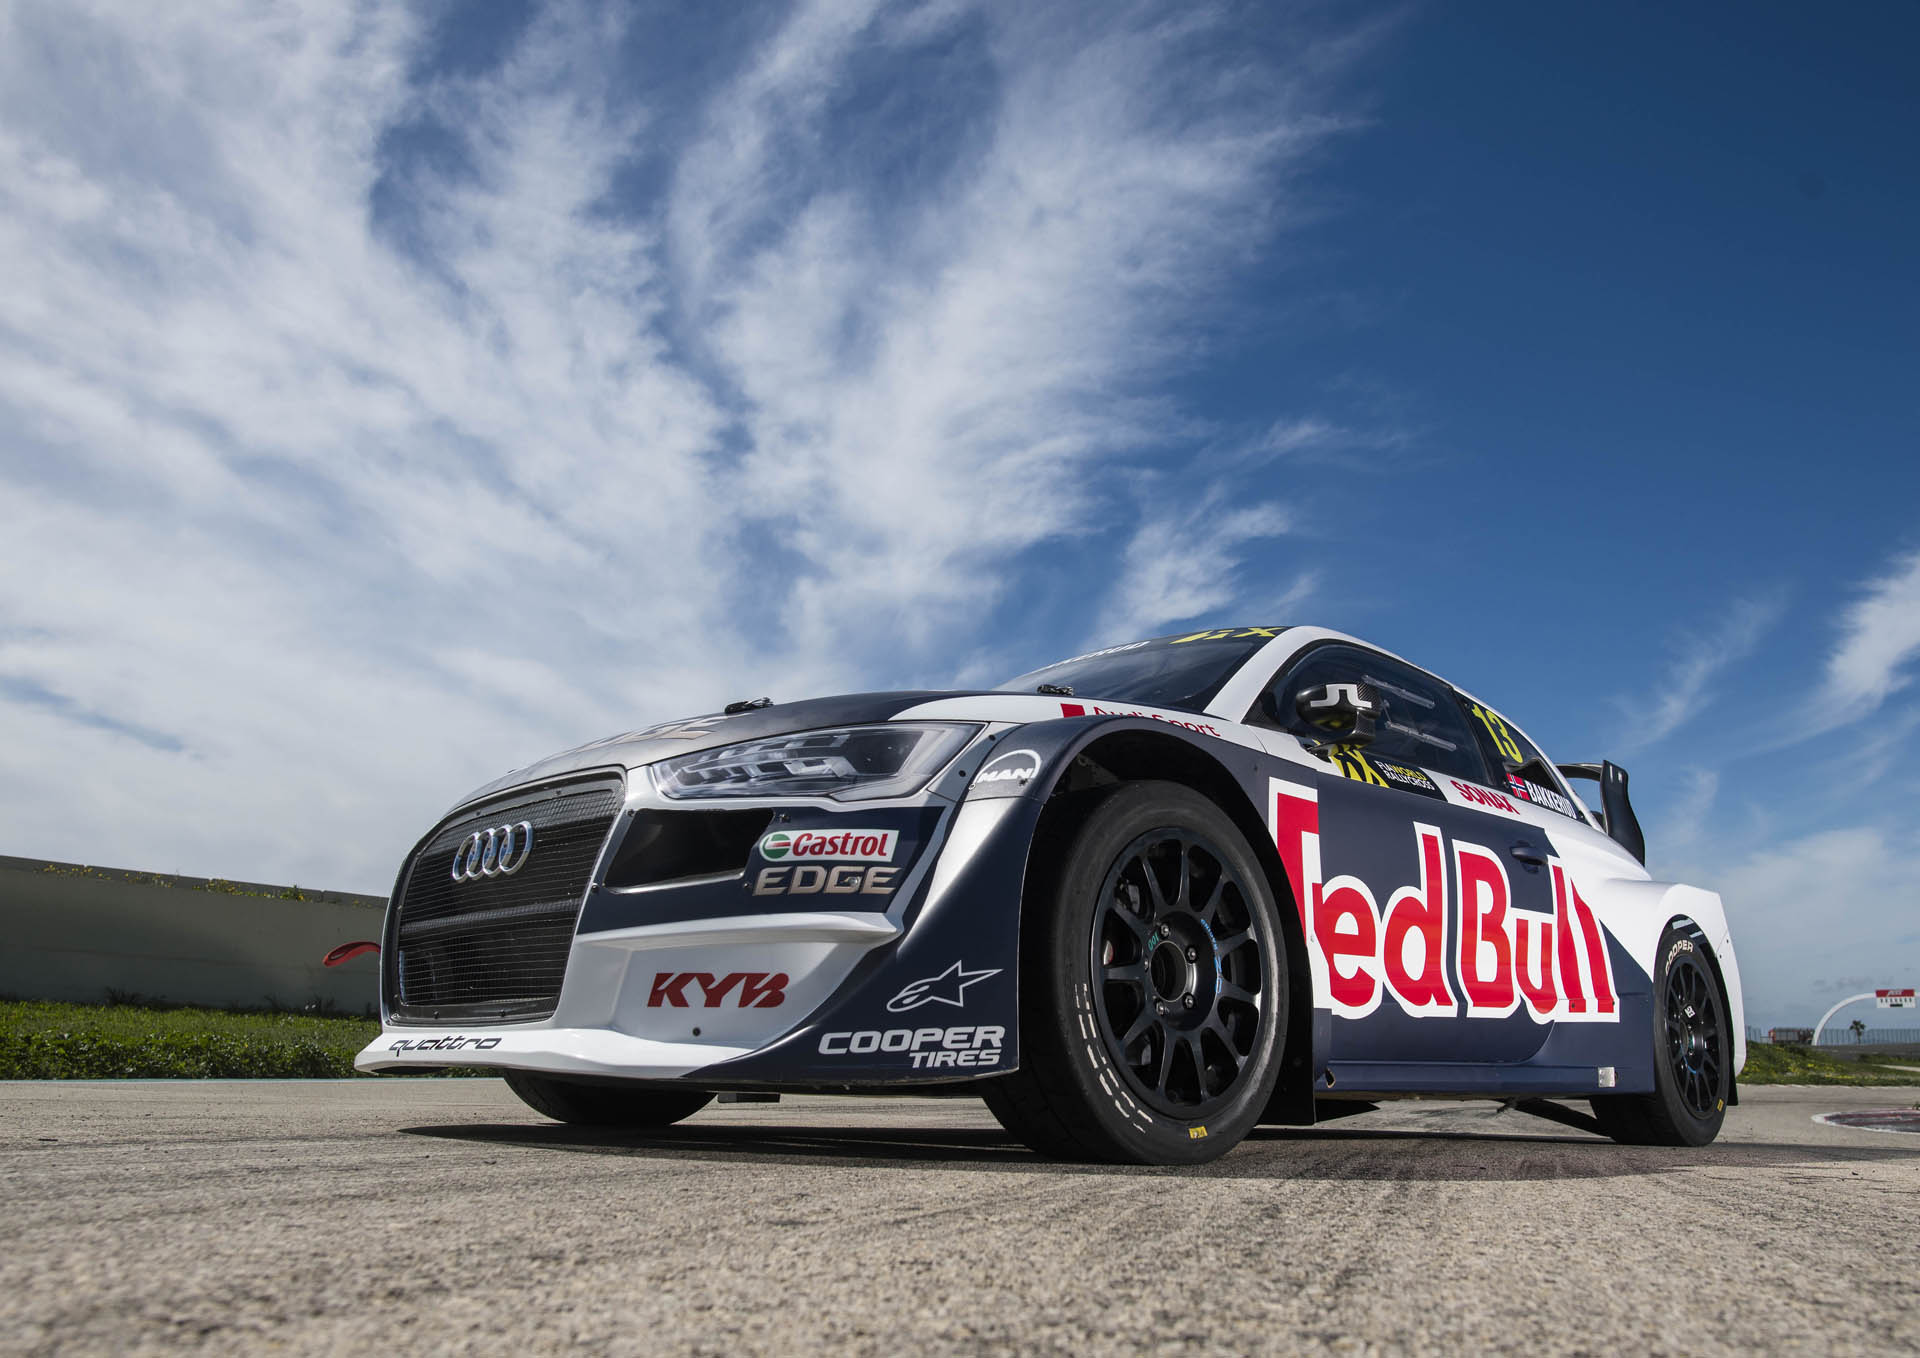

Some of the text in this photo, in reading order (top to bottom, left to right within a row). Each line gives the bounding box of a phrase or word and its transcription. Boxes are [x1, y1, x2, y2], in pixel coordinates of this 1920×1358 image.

[1472, 703, 1523, 763] 13
[977, 767, 1034, 783] MAN
[1383, 770, 1435, 791] RALLYCROSS
[1450, 780, 1521, 815] SONAX
[1524, 779, 1577, 819] BAKKERUD
[792, 831, 888, 857] Castrol
[752, 865, 902, 896] EDGE
[1458, 850, 1616, 1015] Bull
[1665, 939, 1694, 976] COOPER
[646, 972, 790, 1008] KYB
[389, 1036, 503, 1057] quattro
[818, 1025, 1006, 1055] COOPER
[909, 1049, 1002, 1069] TIRES
